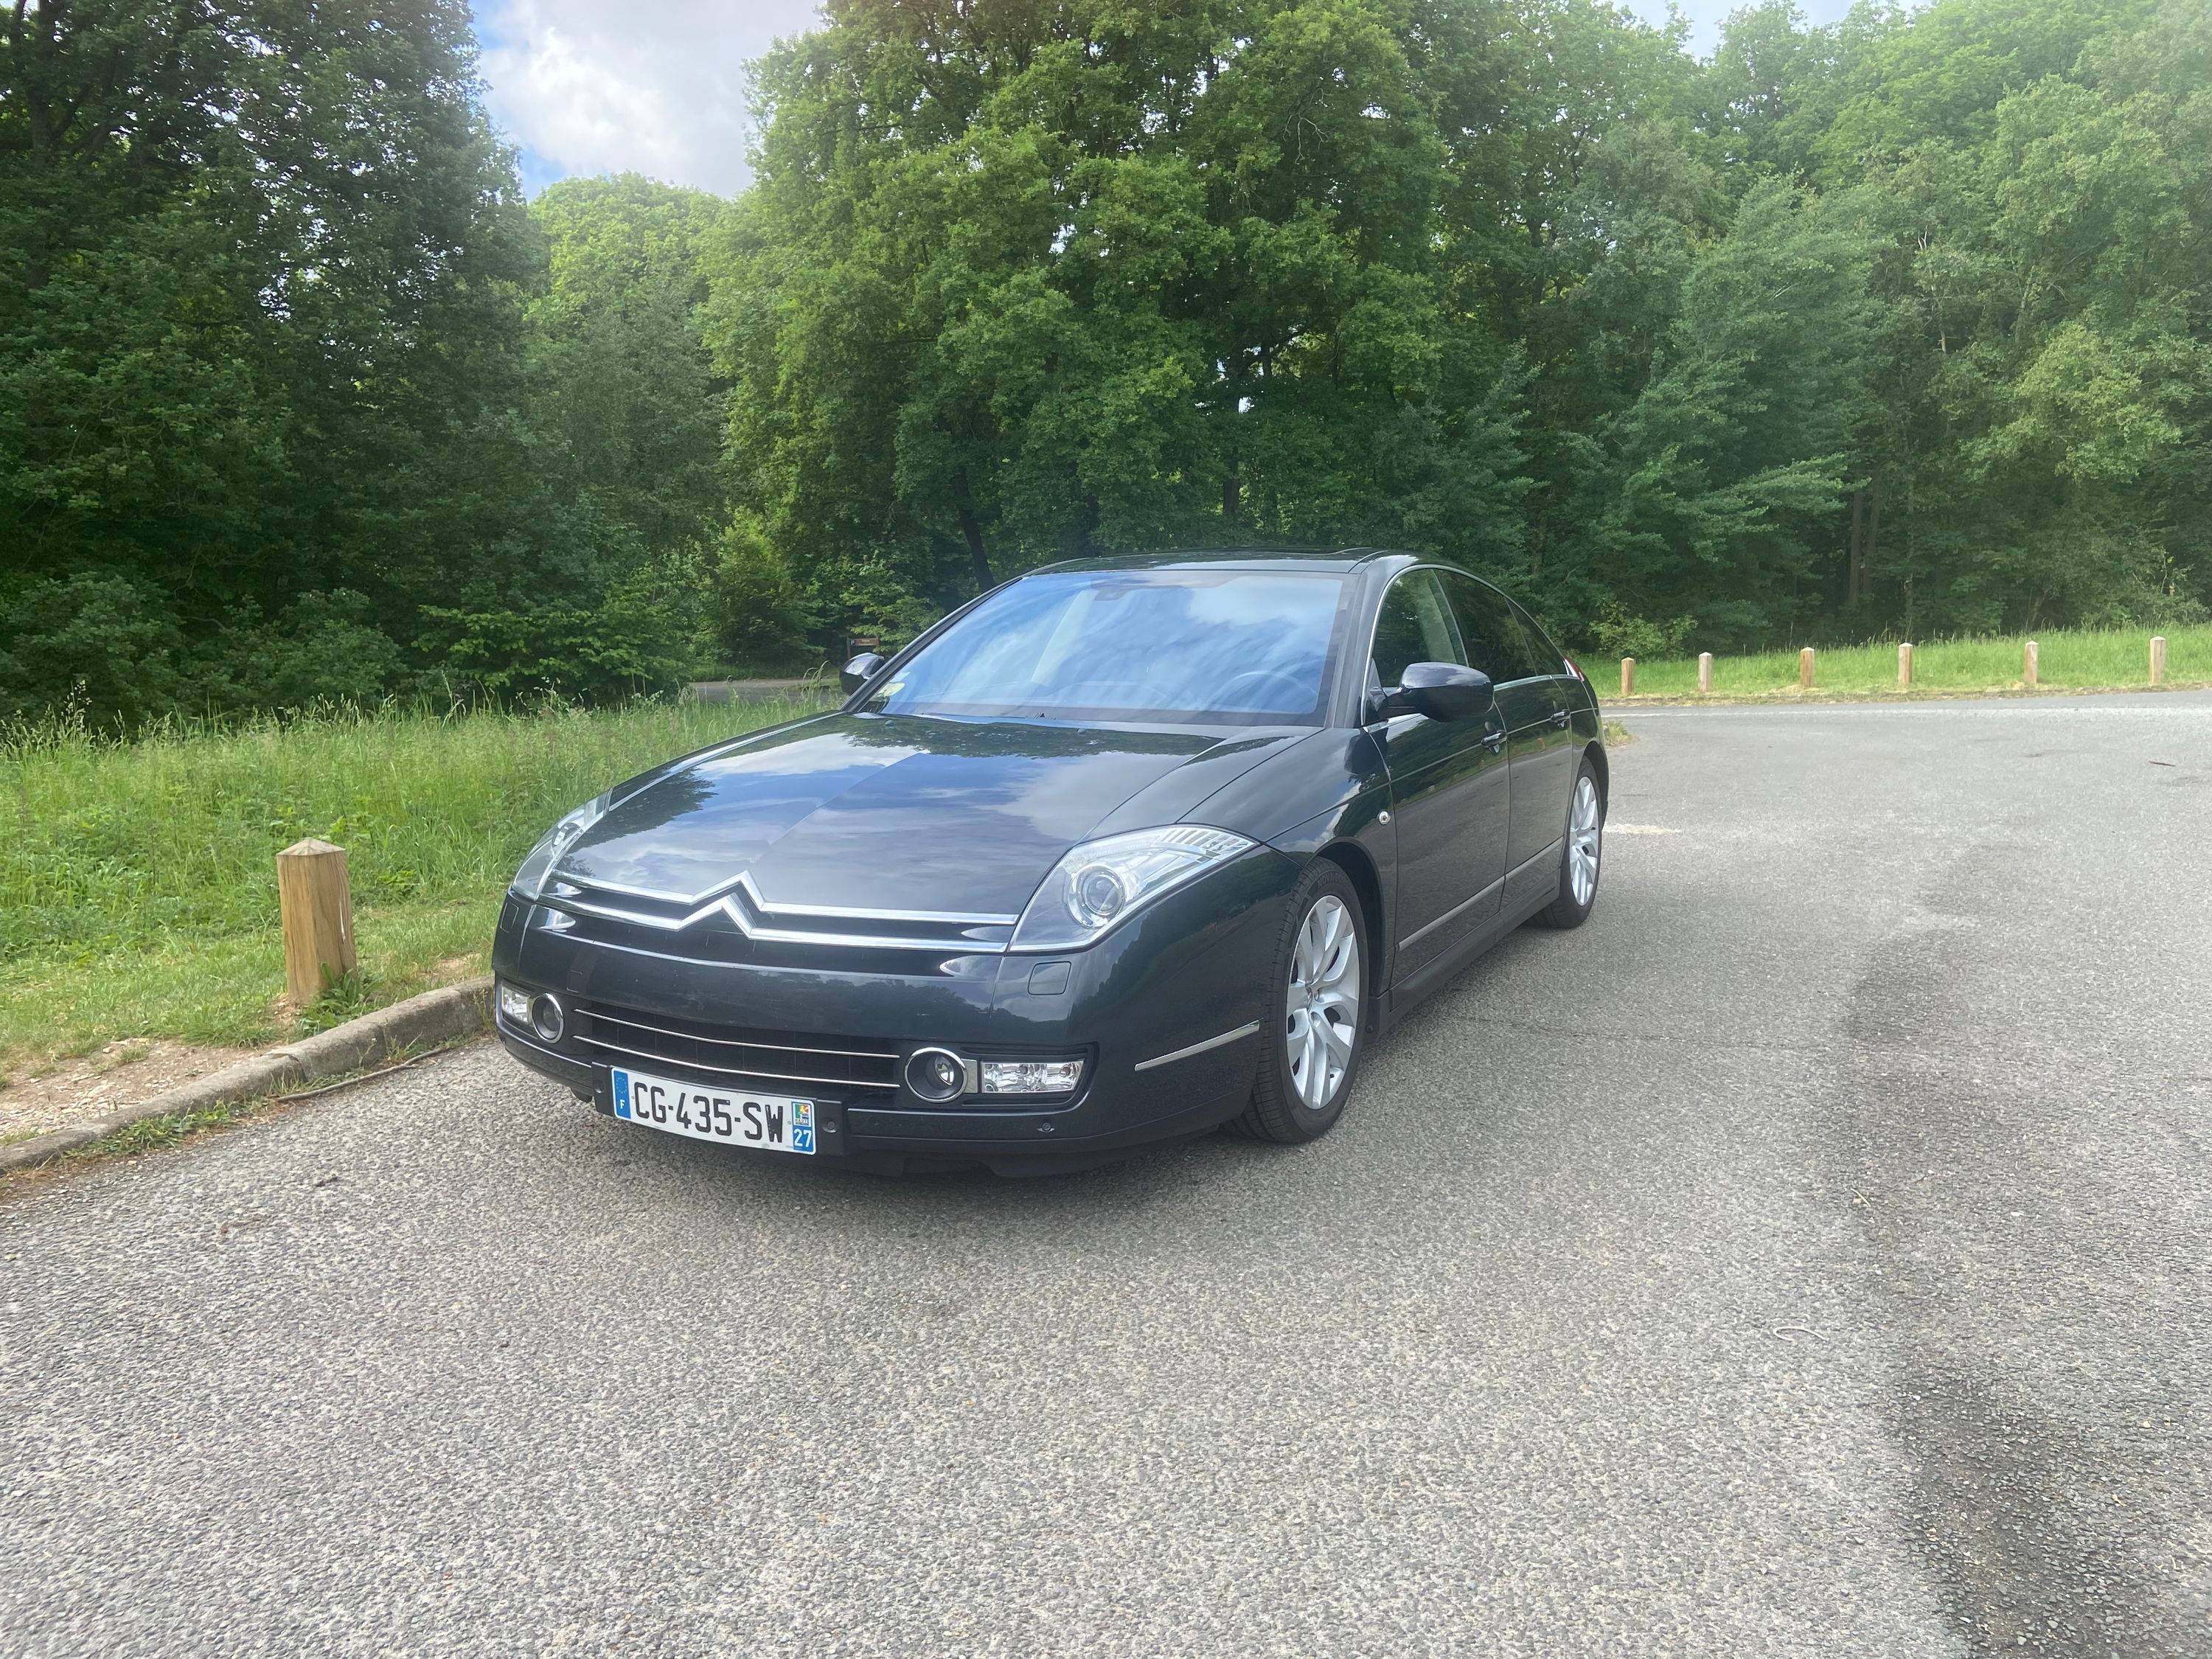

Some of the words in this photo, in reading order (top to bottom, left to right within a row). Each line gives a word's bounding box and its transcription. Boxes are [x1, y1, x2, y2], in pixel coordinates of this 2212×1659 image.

[620, 1099, 625, 1110] F
[634, 1082, 783, 1143] CG-435-SW
[794, 1129, 812, 1147] 27
